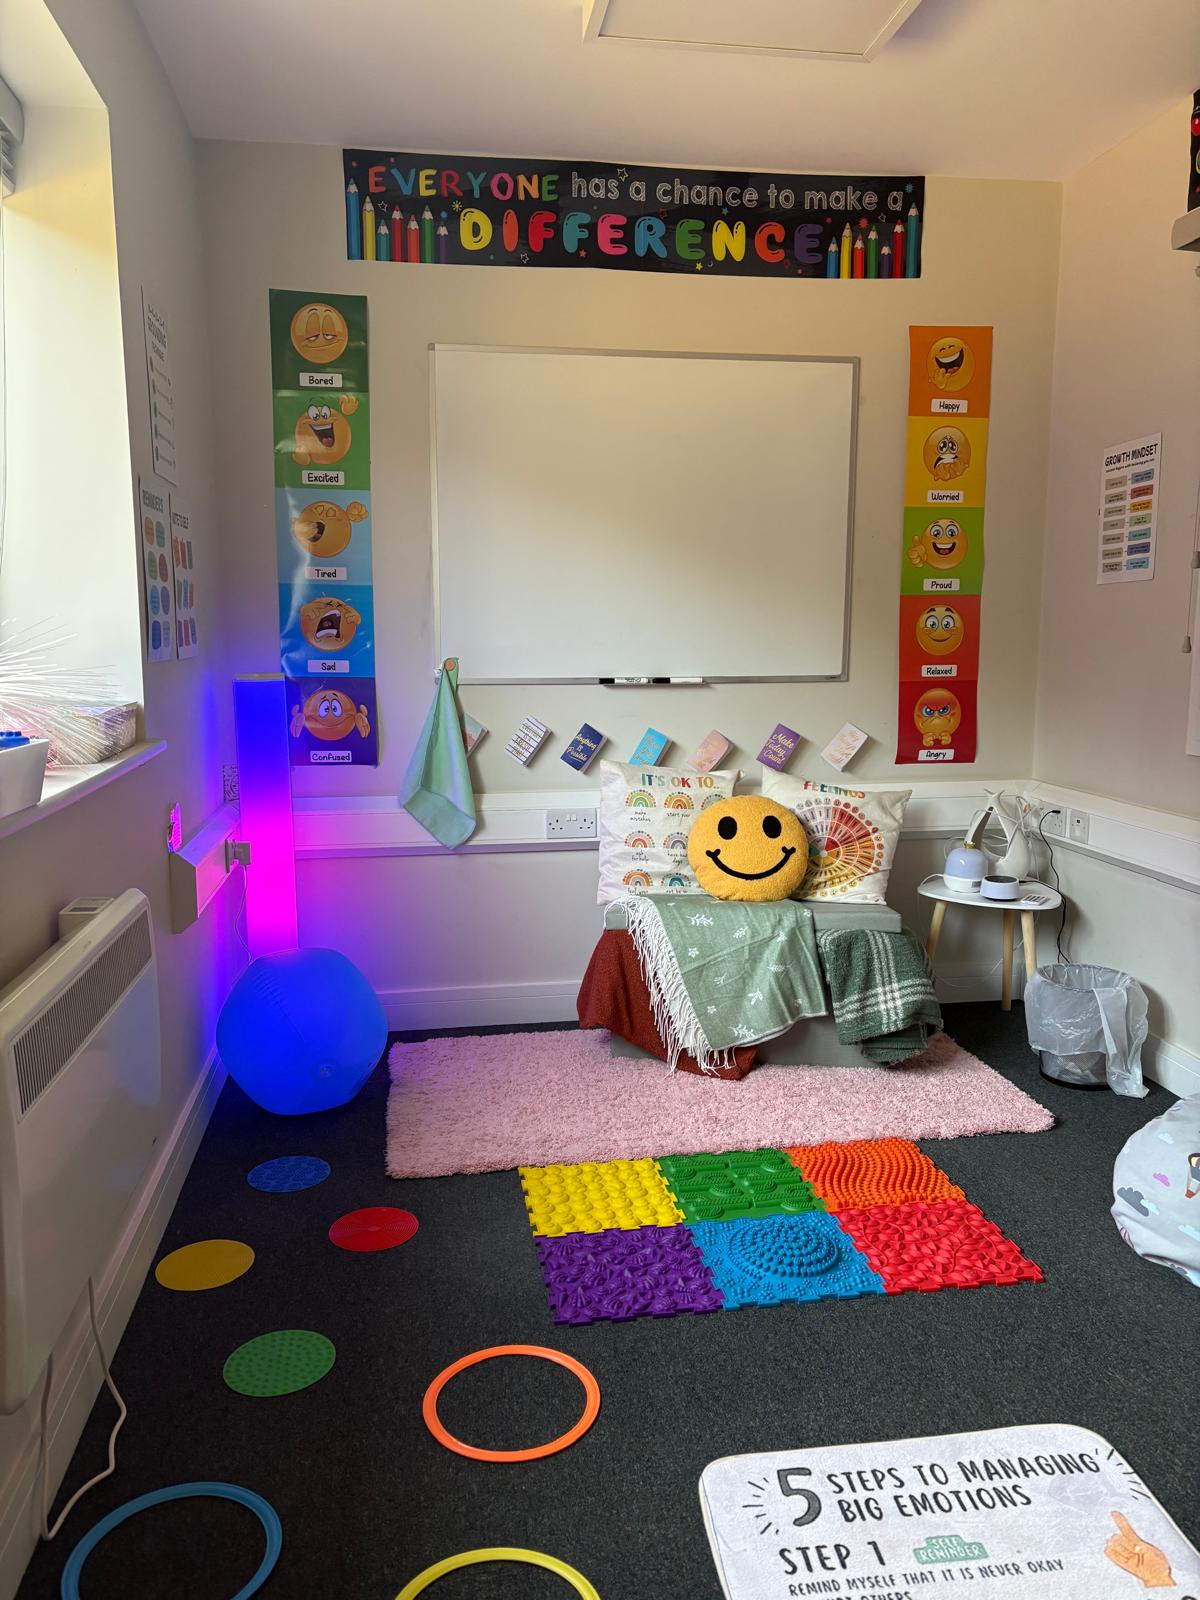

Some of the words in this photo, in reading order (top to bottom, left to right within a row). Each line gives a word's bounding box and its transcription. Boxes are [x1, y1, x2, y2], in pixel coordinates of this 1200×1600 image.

[368, 165, 560, 201] EVERYONE
[571, 171, 620, 200] has
[629, 180, 646, 202] a
[655, 178, 759, 208] chance
[767, 183, 795, 209] to
[804, 186, 879, 211] make
[887, 190, 904, 212] a
[459, 206, 824, 265] DIFFERENCE
[308, 375, 334, 385] Bored
[939, 400, 961, 413] Happy
[1104, 450, 1131, 467] GROWTH
[1130, 443, 1159, 461] MINDSET
[307, 472, 339, 483] Excited
[931, 492, 960, 501] Worried
[314, 569, 337, 579] Tired
[930, 580, 953, 590] Proud
[321, 662, 336, 672] Sad
[926, 666, 953, 676] Relaxed
[772, 733, 795, 749] Make
[311, 752, 351, 762] Confused
[925, 750, 947, 760] Angry
[641, 773, 666, 787] IT'S
[670, 777, 692, 789] OK
[776, 1466, 822, 1527] 5
[826, 1467, 905, 1495] STEPS
[912, 1463, 950, 1486] TO
[957, 1452, 1101, 1483] MANAGING
[837, 1497, 884, 1523] BIG
[893, 1484, 1032, 1517] EMOTIONS
[931, 1537, 960, 1549] SELF
[778, 1543, 851, 1576] STEP
[867, 1540, 886, 1566] 1
[918, 1545, 983, 1562] REMINDER
[788, 1578, 842, 1597] REMIND
[846, 1573, 897, 1591] MYSELF
[902, 1570, 937, 1586] THAT
[941, 1568, 956, 1582] IT
[960, 1567, 975, 1580] IS
[978, 1562, 1025, 1579] NEVER
[1027, 1558, 1065, 1574] OKAY
